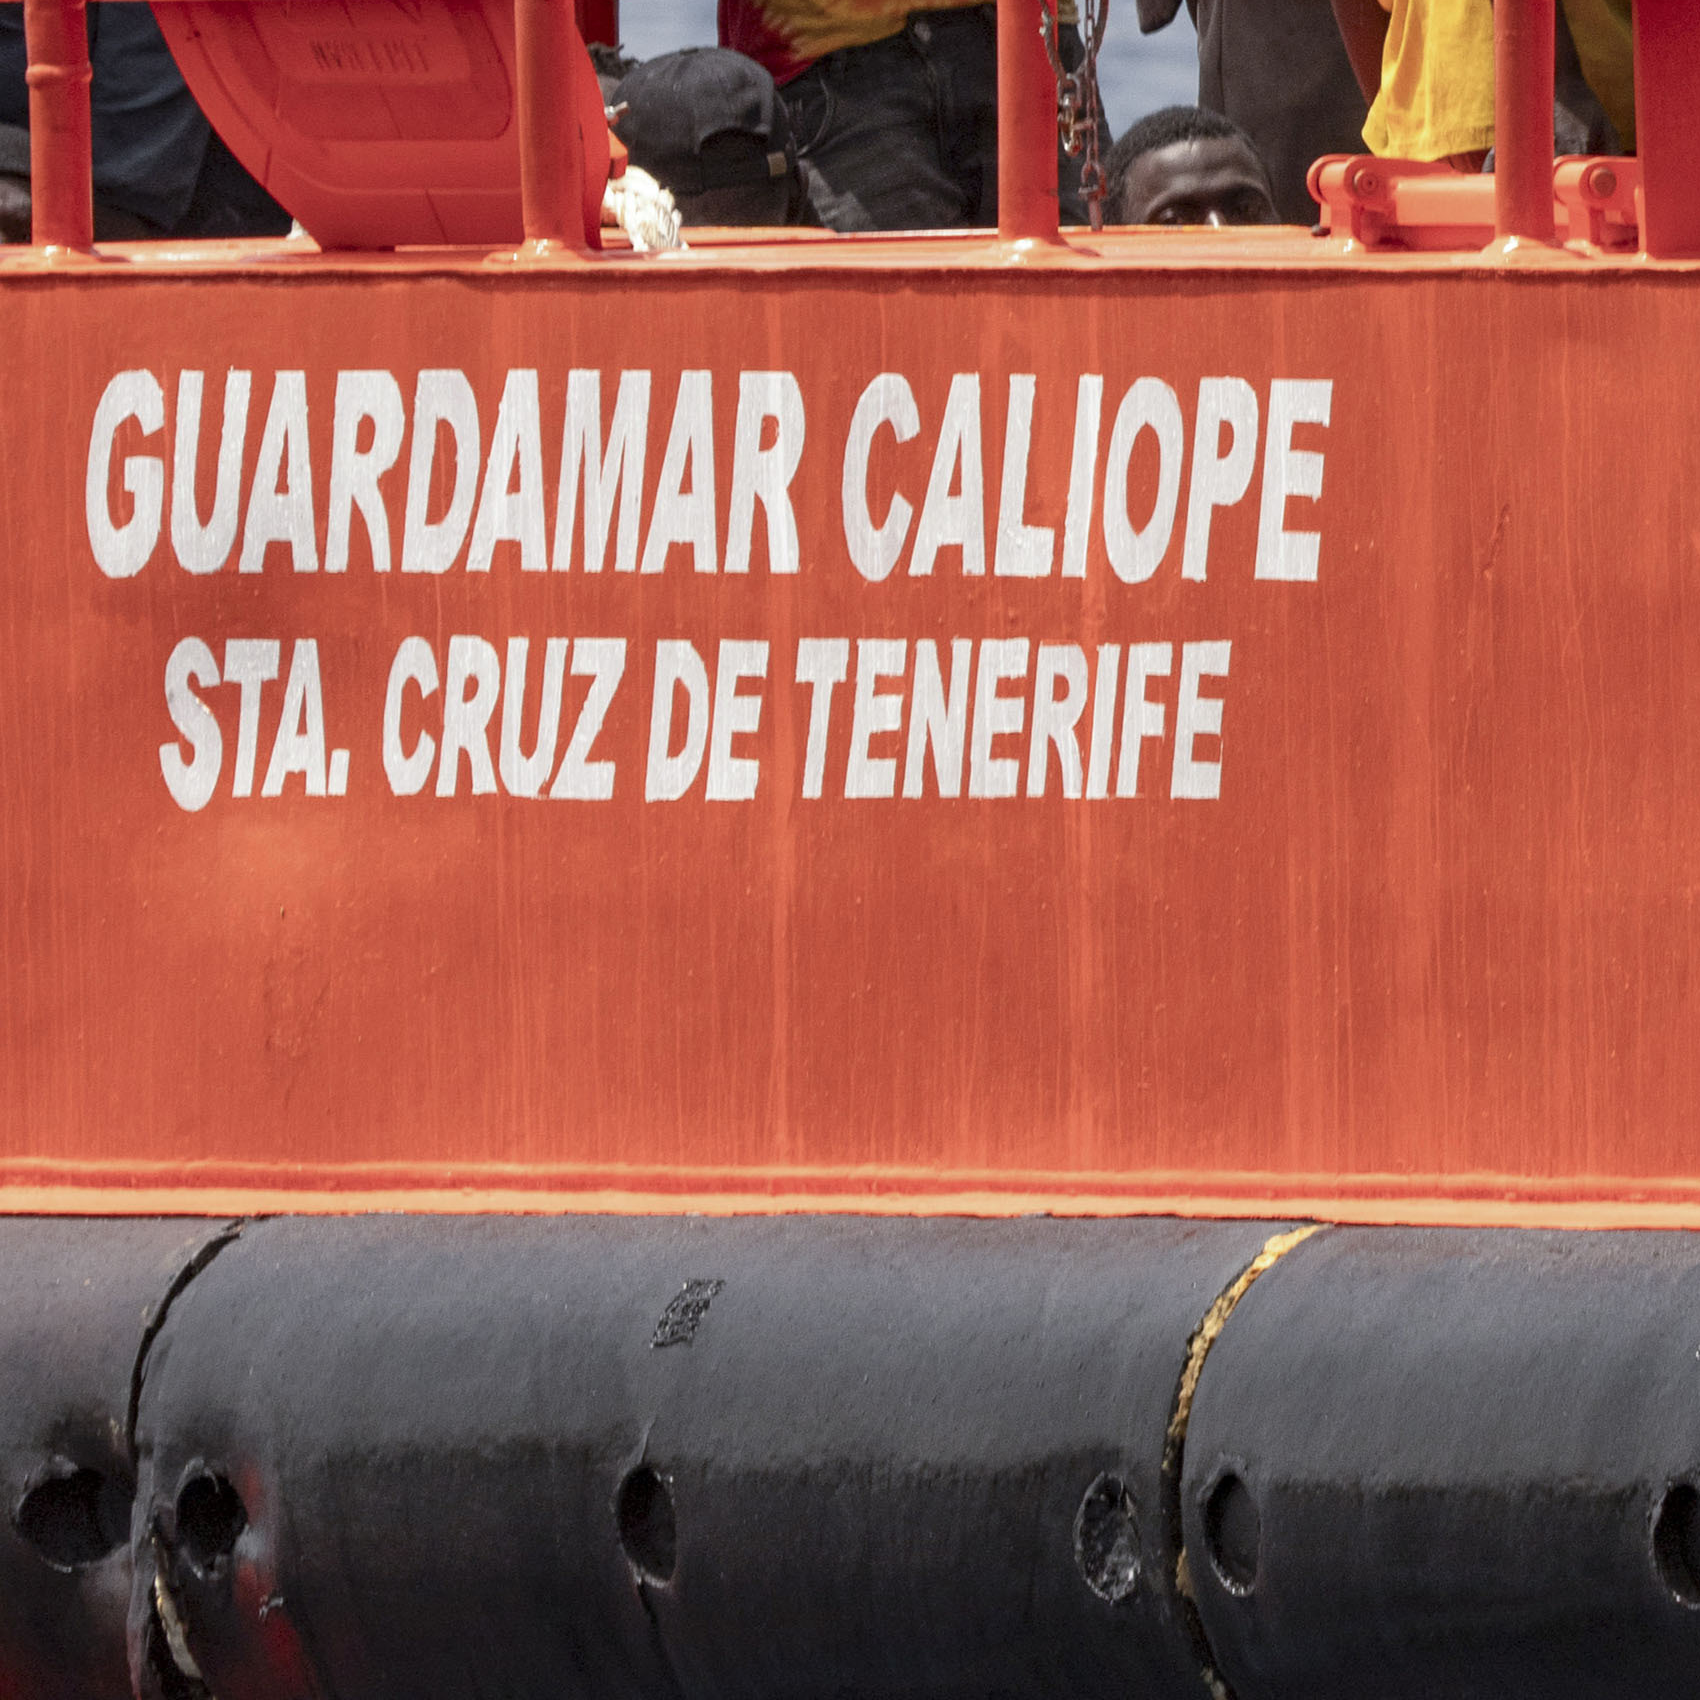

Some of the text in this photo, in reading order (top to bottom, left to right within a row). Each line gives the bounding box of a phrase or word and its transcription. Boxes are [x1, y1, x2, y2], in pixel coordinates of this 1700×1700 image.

[86, 368, 1334, 584] GUARDAMAR CALIOPE
[160, 634, 1233, 812] STA. CRUZ DE TENERIFE
